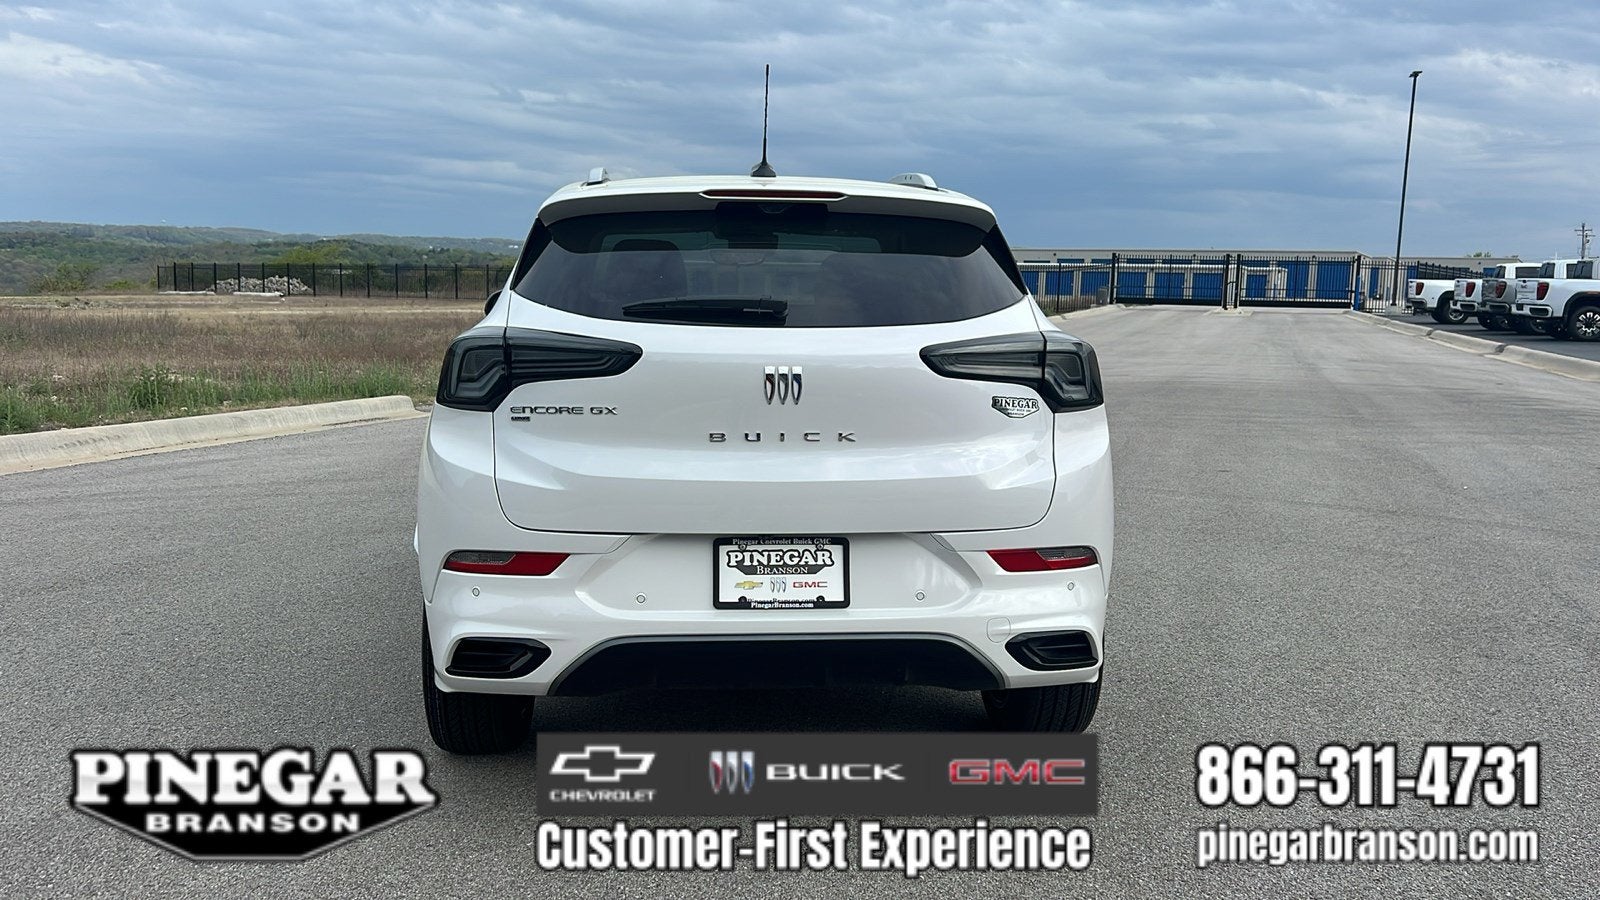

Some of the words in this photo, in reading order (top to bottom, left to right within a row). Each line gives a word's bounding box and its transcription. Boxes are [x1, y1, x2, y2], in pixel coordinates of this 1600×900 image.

[993, 398, 1037, 409] PINEGAR
[510, 406, 584, 415] ENCORE
[590, 406, 618, 415] GX
[709, 432, 856, 443] BUICK
[732, 538, 758, 546] Pinegar
[728, 550, 833, 567] PINEGAR
